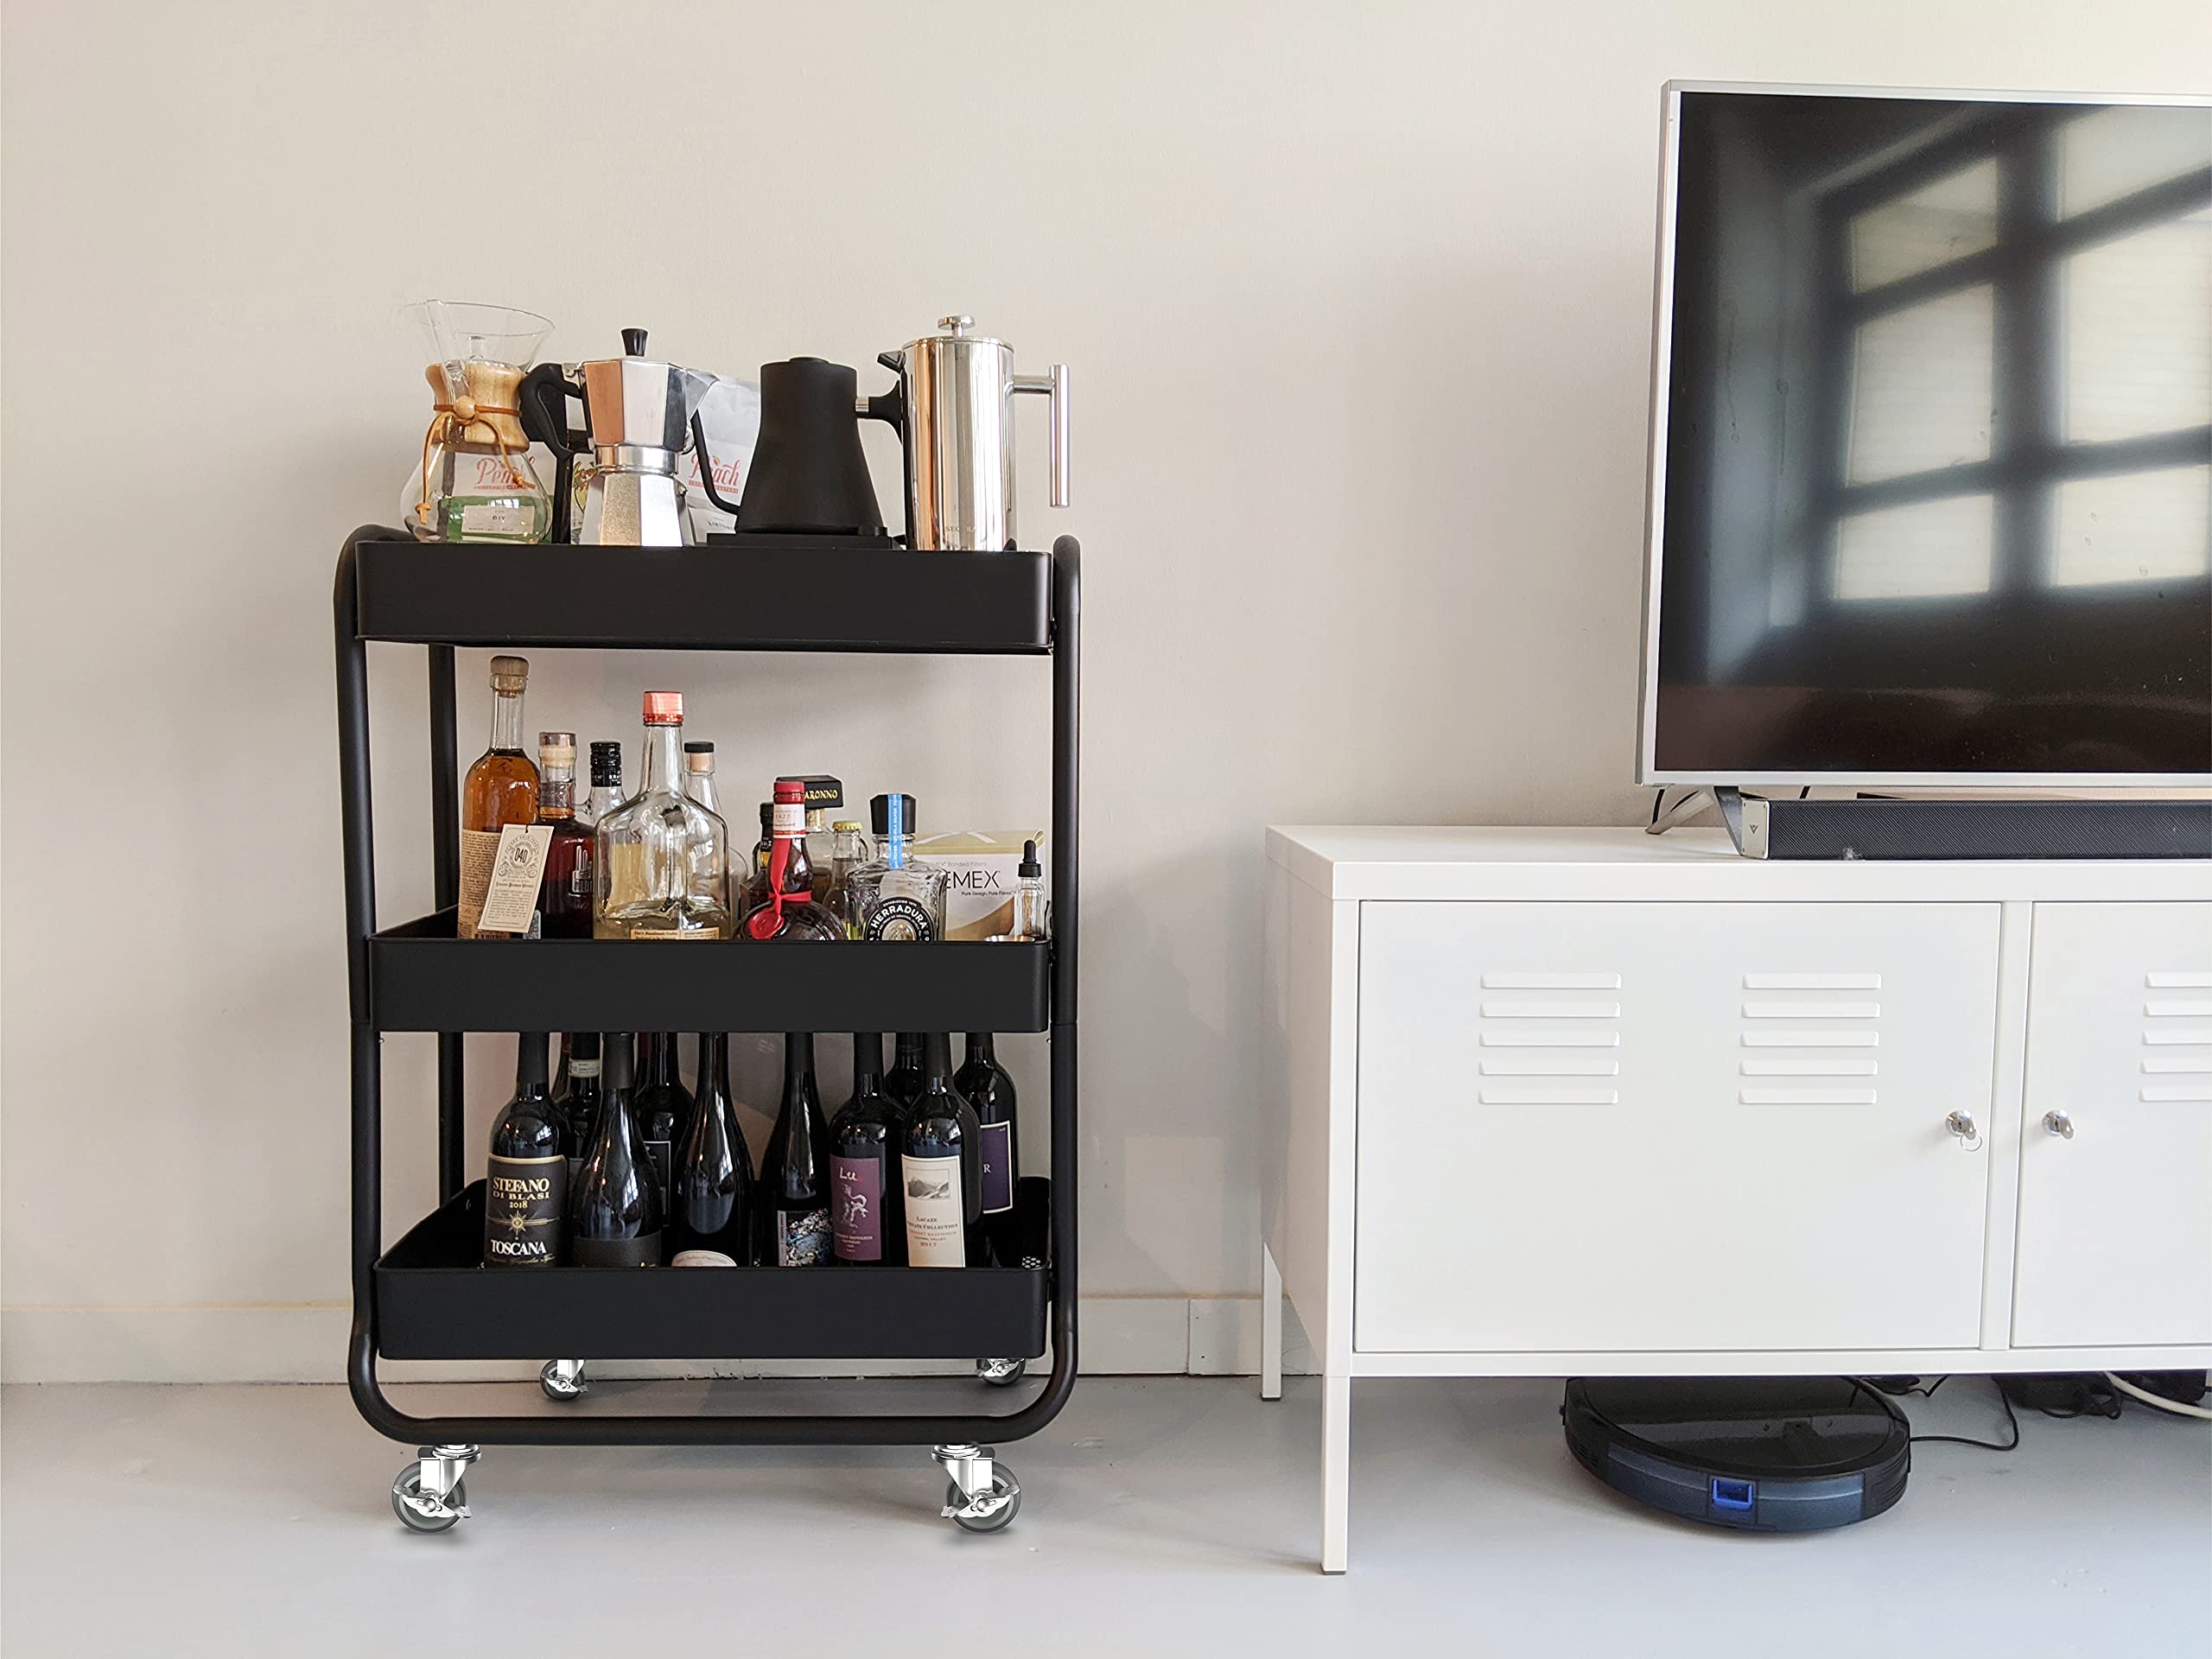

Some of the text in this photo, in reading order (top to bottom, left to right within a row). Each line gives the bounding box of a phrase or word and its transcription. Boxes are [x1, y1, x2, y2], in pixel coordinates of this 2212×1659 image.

[689, 454, 741, 486] Pach
[871, 905, 927, 929] HERRADURA
[493, 1177, 550, 1192] STEFANO
[491, 1239, 547, 1255] TOSCANA
